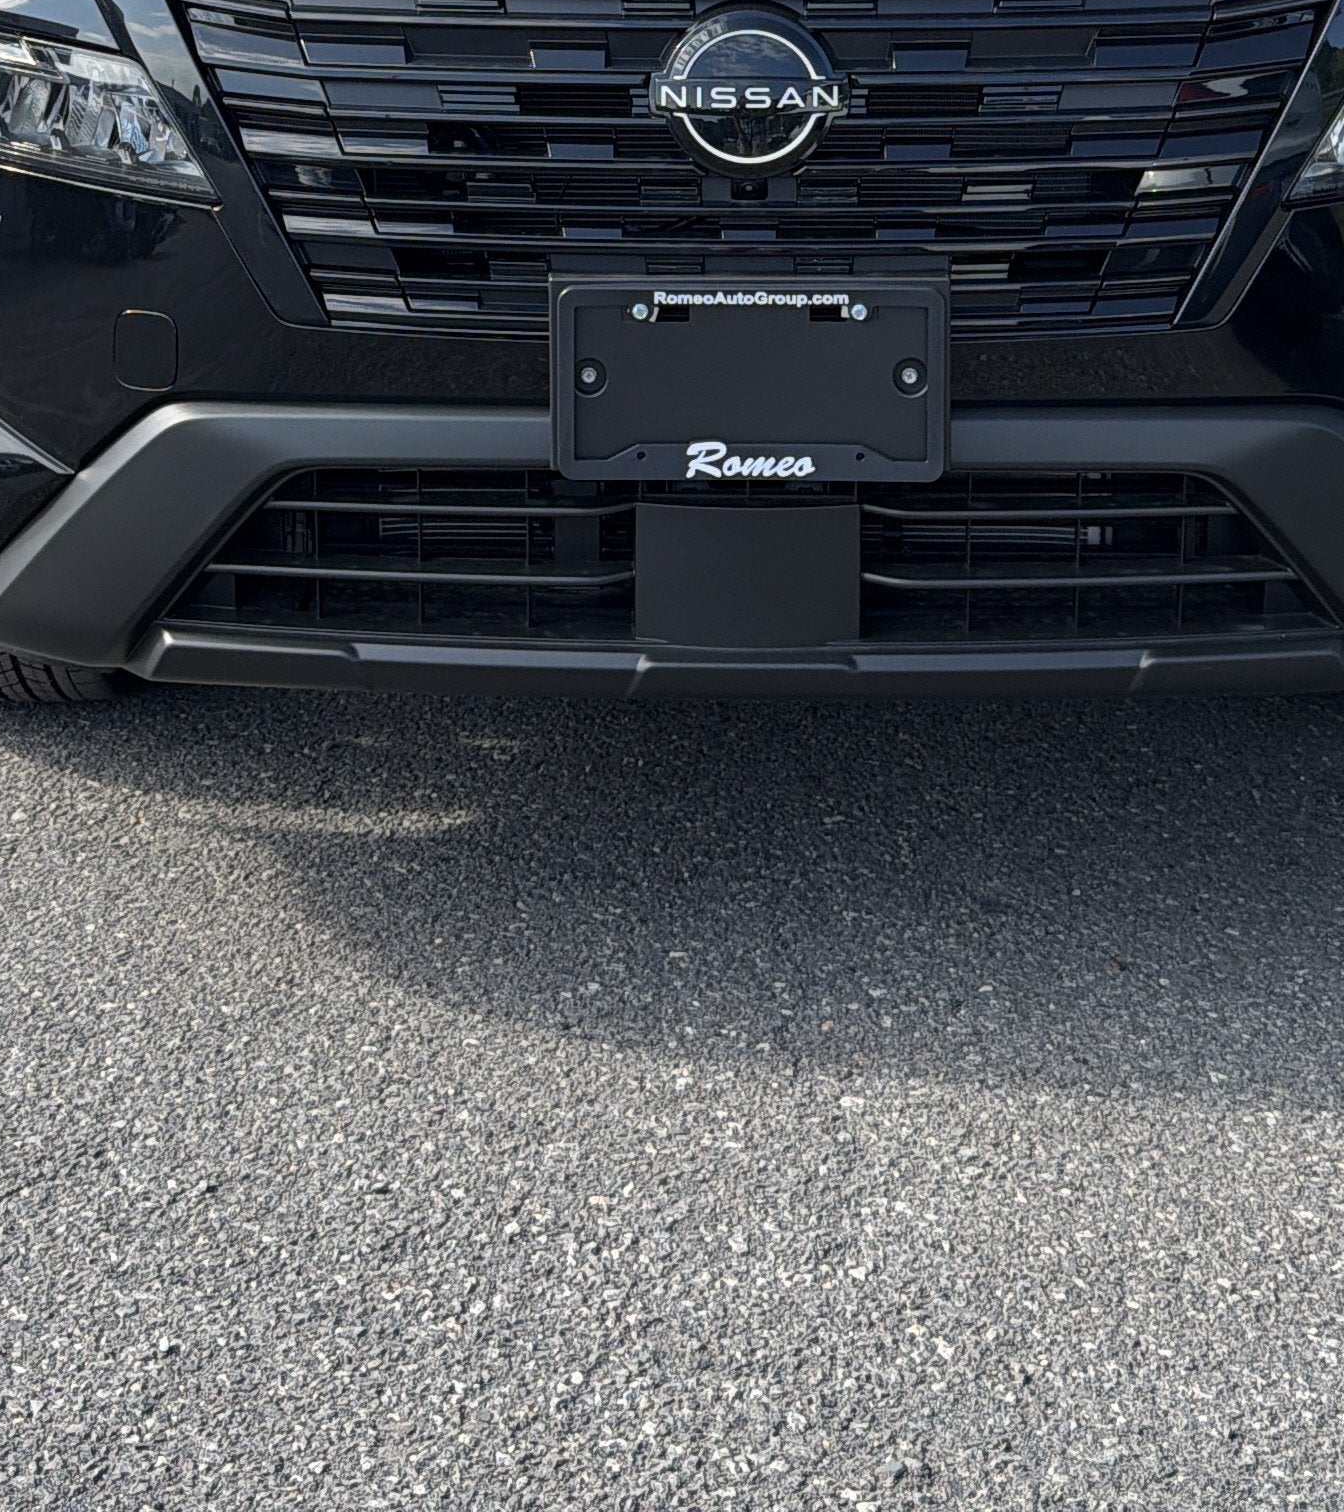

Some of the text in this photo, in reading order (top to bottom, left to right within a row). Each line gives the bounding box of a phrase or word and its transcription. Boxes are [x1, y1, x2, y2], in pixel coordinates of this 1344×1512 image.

[660, 85, 839, 109] NISSAN
[653, 291, 850, 308] RomeoAutoGroup.com
[685, 441, 817, 479] Romeo
